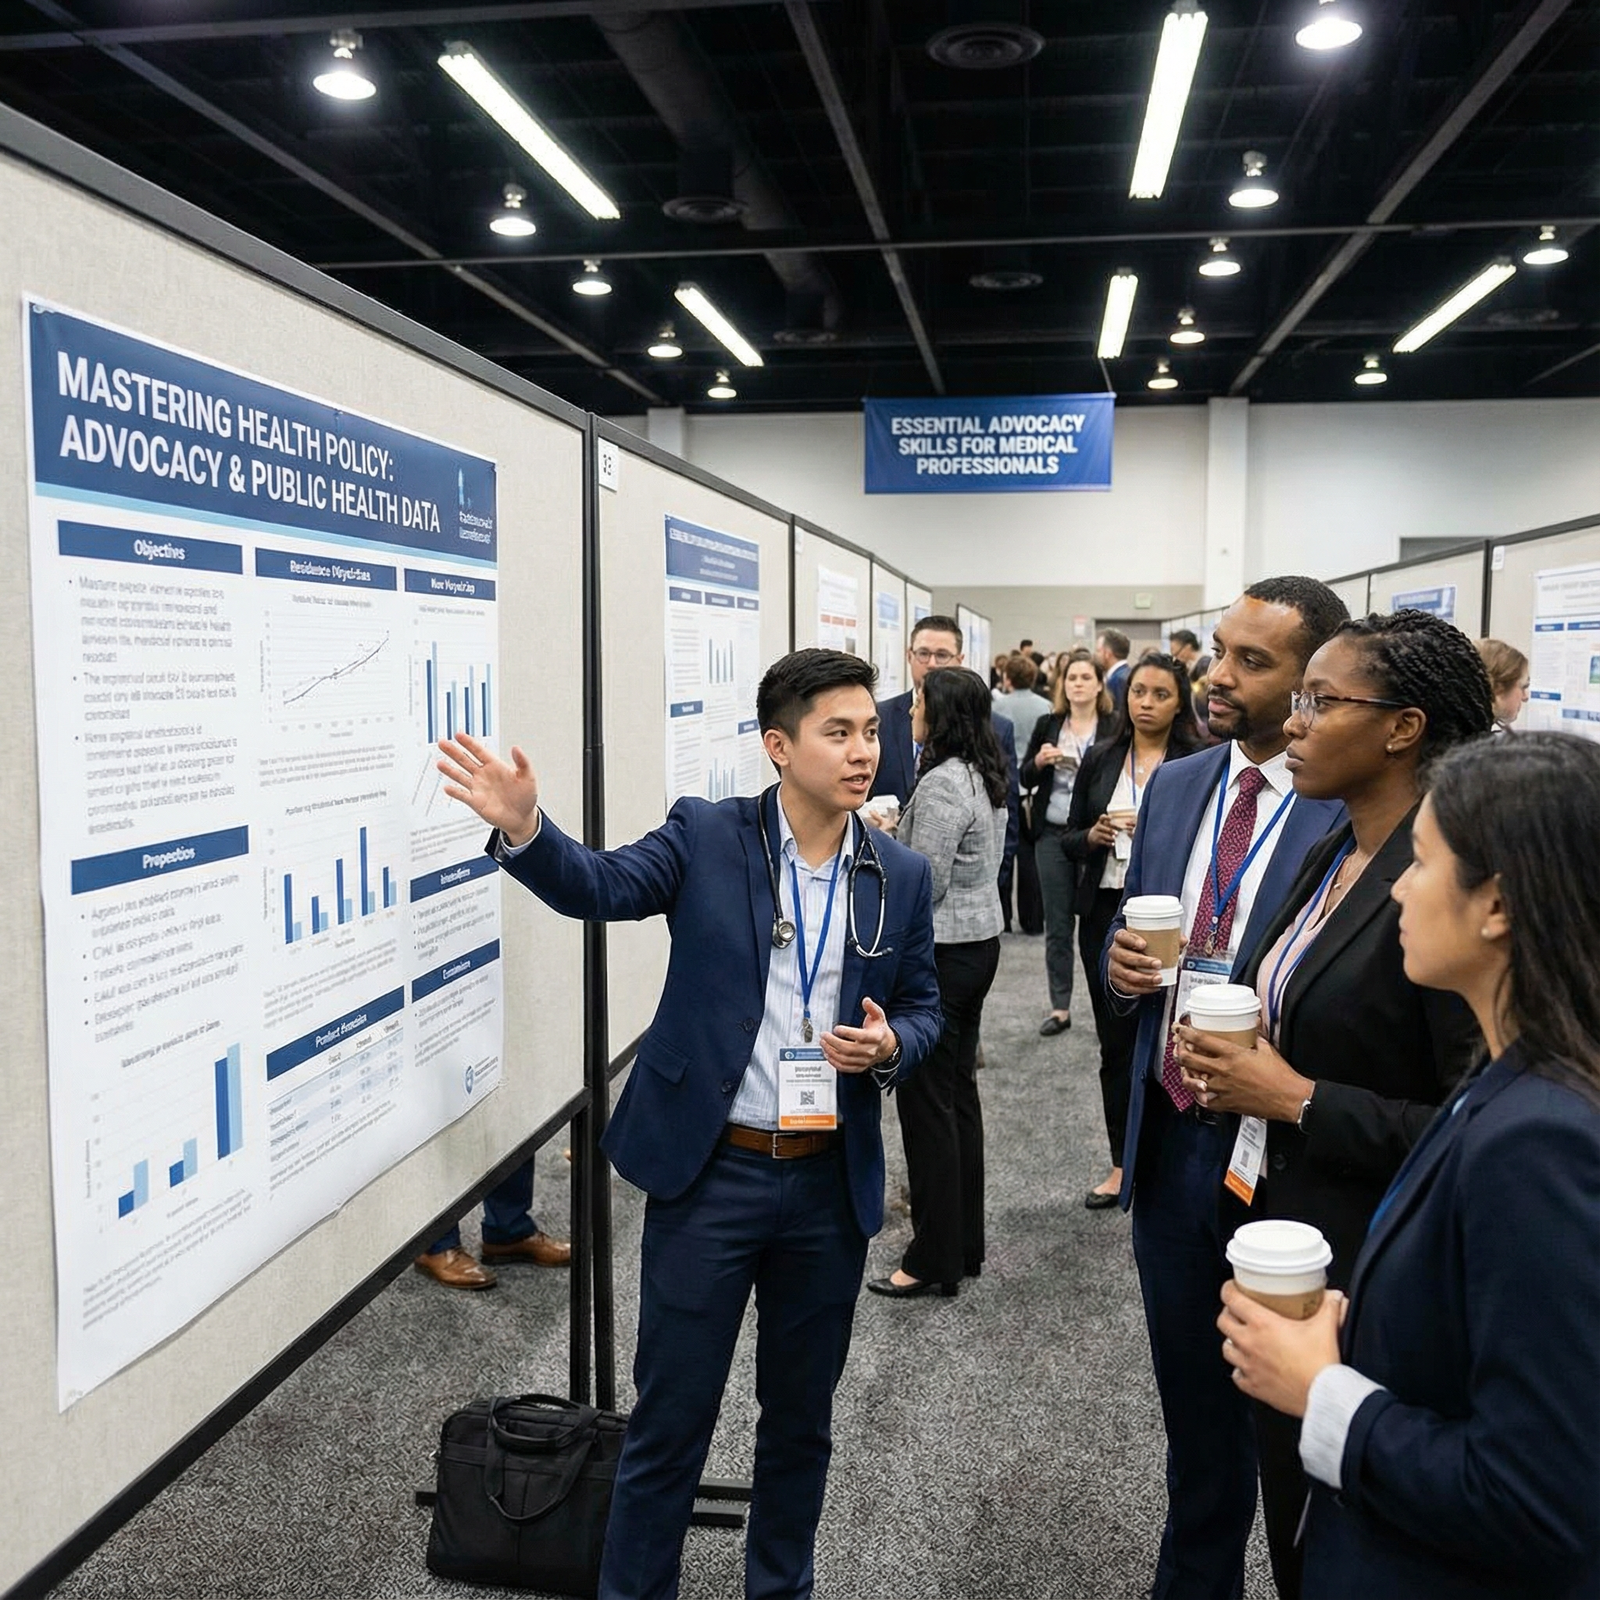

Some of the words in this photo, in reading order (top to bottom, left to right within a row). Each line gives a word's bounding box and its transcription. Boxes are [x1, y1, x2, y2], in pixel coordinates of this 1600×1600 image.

[57, 350, 232, 438] MASTERING
[237, 404, 322, 462] HEALTH
[325, 431, 394, 482] POLICY:
[891, 416, 985, 435] ESSENTIAL
[988, 414, 1086, 433] ADVOCACY
[899, 437, 958, 456] SKILLS
[961, 436, 996, 455] FOR
[999, 435, 1079, 454] MEDICAL
[59, 414, 223, 488] ADVOCACY
[228, 454, 246, 494] &
[251, 459, 327, 510] PUBLIC
[331, 479, 398, 526] HEALTH
[402, 496, 441, 533] DATA
[916, 456, 1060, 475] PROFESSIONALS
